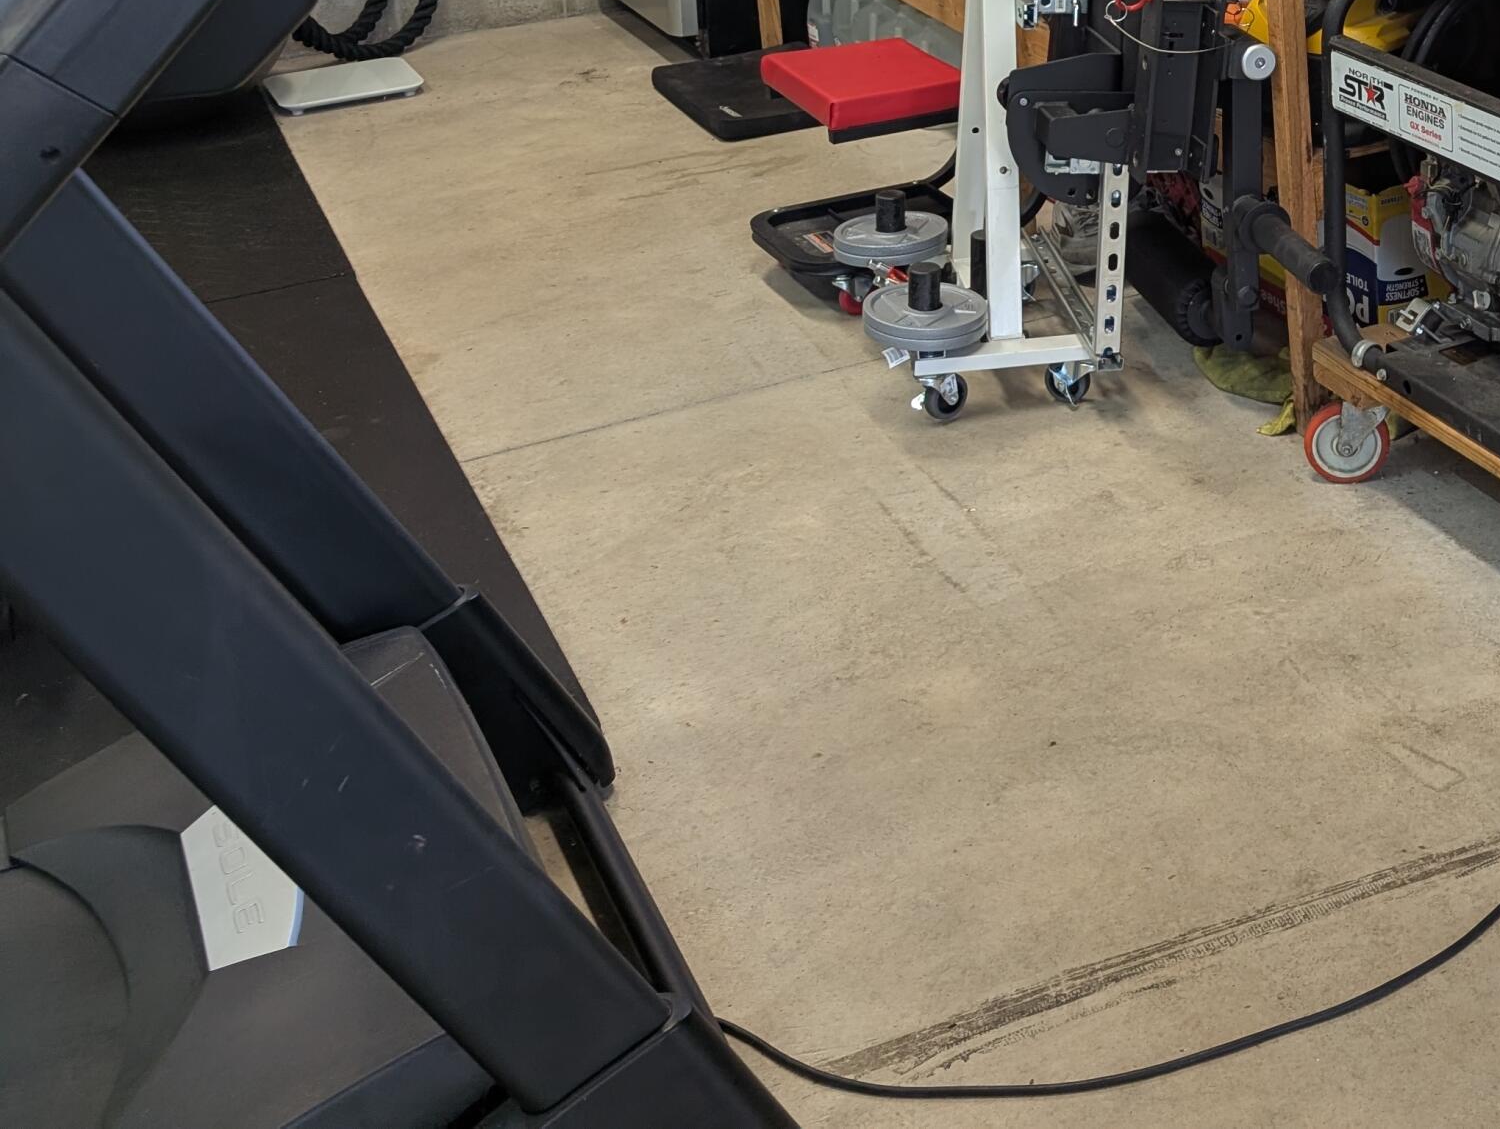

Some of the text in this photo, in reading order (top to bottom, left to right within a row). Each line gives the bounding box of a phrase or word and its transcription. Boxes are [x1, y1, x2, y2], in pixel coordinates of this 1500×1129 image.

[1348, 67, 1384, 87] NORTH
[1404, 93, 1447, 119] HONDA
[1406, 105, 1445, 129] ENGINES
[1410, 121, 1442, 142] GX Series
[1347, 273, 1368, 289] TOILE
[1386, 278, 1419, 292] STRENGTH
[1260, 290, 1286, 312] Shee
[1385, 286, 1420, 301] SOFTNESS
[209, 819, 266, 934] SOLE
